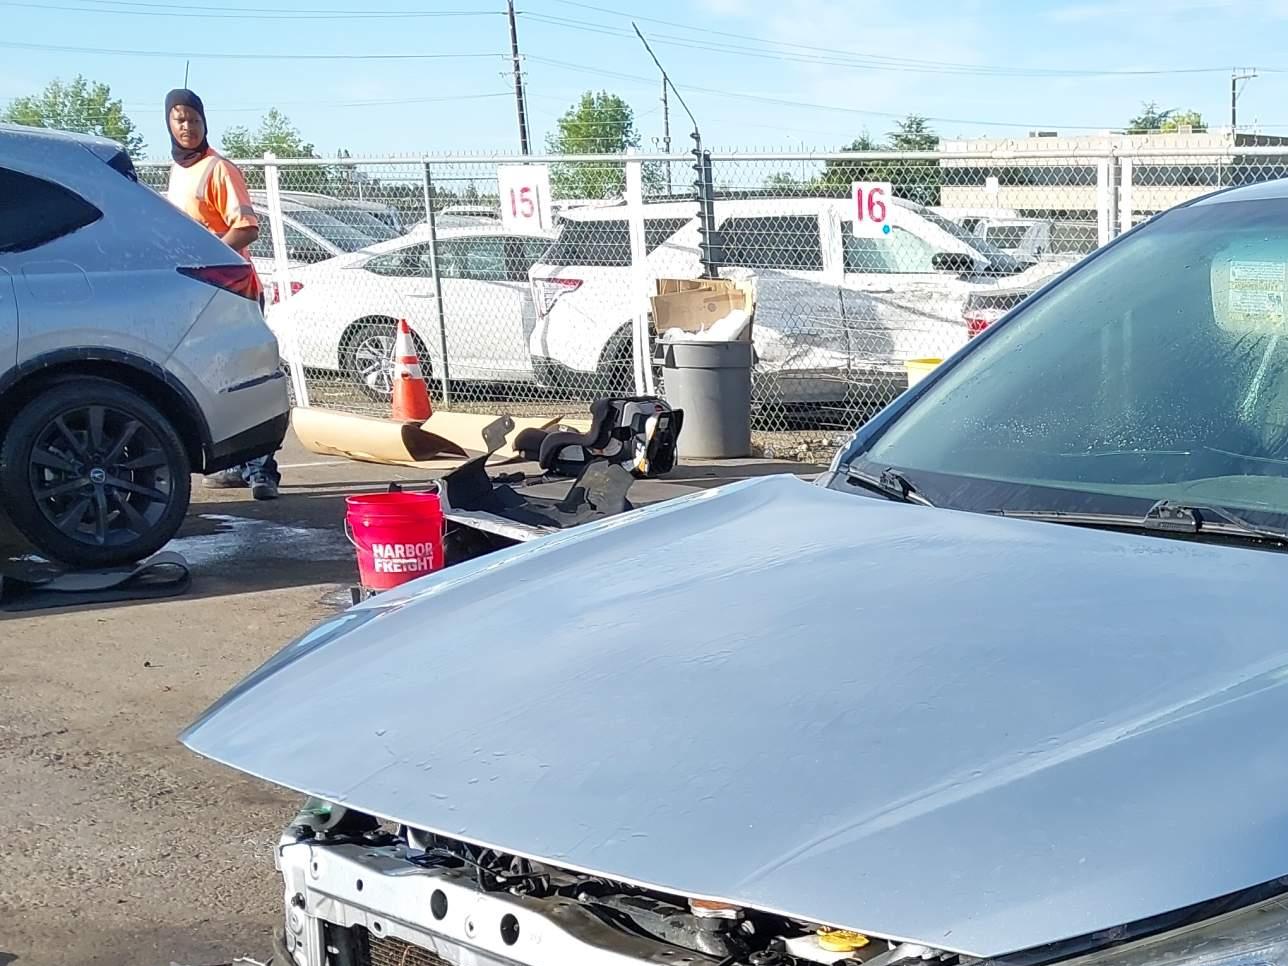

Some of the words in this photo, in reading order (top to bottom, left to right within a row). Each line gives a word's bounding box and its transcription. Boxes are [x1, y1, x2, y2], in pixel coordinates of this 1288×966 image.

[510, 187, 534, 218] 15
[857, 187, 886, 222] 16
[372, 543, 433, 559] HARBOR
[374, 556, 434, 573] FREIGHT
